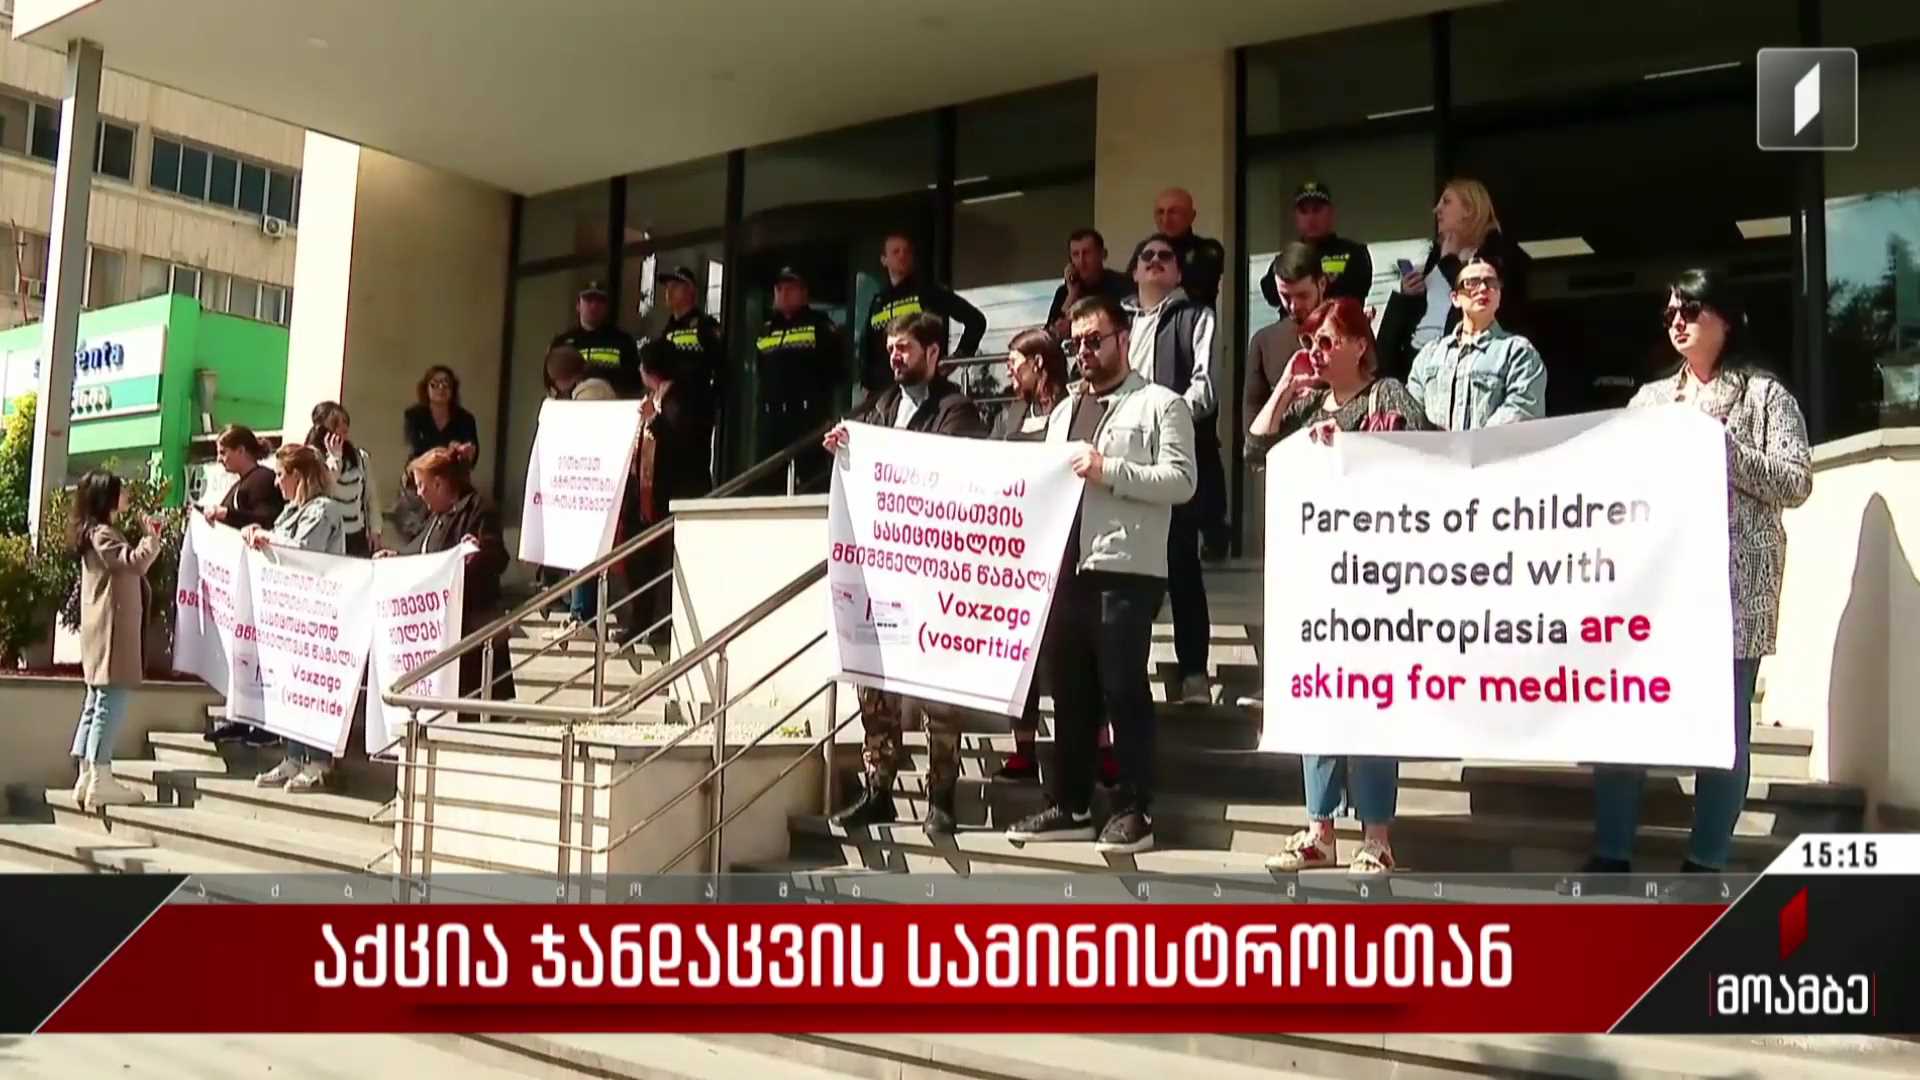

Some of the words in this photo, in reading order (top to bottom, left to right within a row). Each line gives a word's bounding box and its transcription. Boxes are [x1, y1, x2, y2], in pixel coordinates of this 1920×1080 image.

[1301, 501, 1431, 535] Parents
[1443, 498, 1480, 533] of
[1492, 493, 1652, 532] children
[1330, 550, 1513, 594] diagnosed
[1527, 548, 1616, 586] with
[938, 591, 1031, 631] Voxzogo
[1301, 607, 1568, 655] achondroplasia
[1580, 614, 1652, 644] are
[292, 663, 342, 693] Voxzogo
[1291, 663, 1394, 710] asking
[1407, 663, 1467, 702] for
[1479, 665, 1671, 704] medicine
